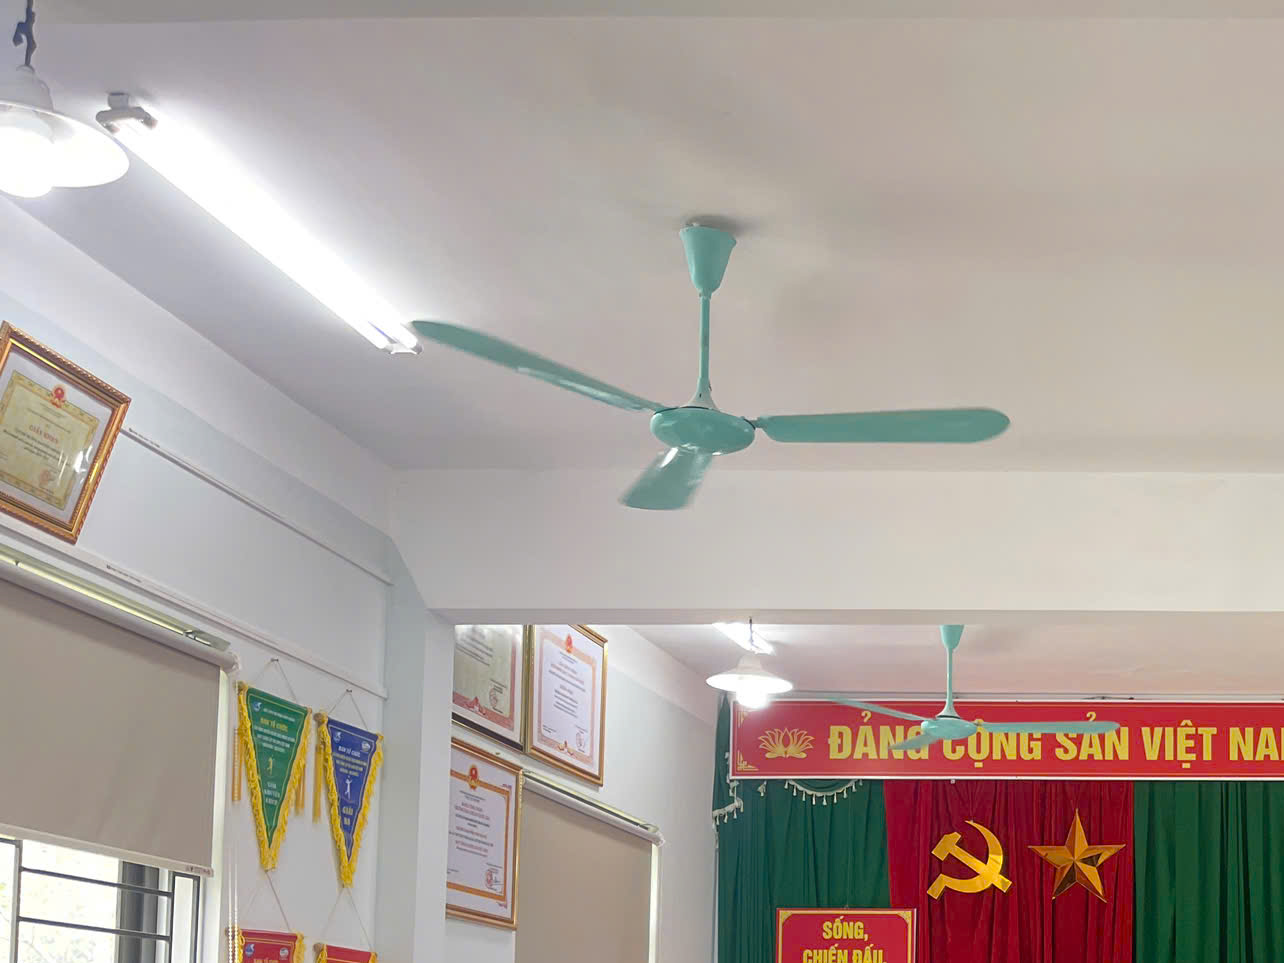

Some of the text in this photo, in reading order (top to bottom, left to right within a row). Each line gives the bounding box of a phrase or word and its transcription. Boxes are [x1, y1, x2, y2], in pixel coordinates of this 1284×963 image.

[828, 711, 929, 760] ĐẢNG
[1055, 711, 1129, 760] SẢN
[1141, 720, 1217, 768] VIỆT
[823, 916, 869, 941] SỐNG,
